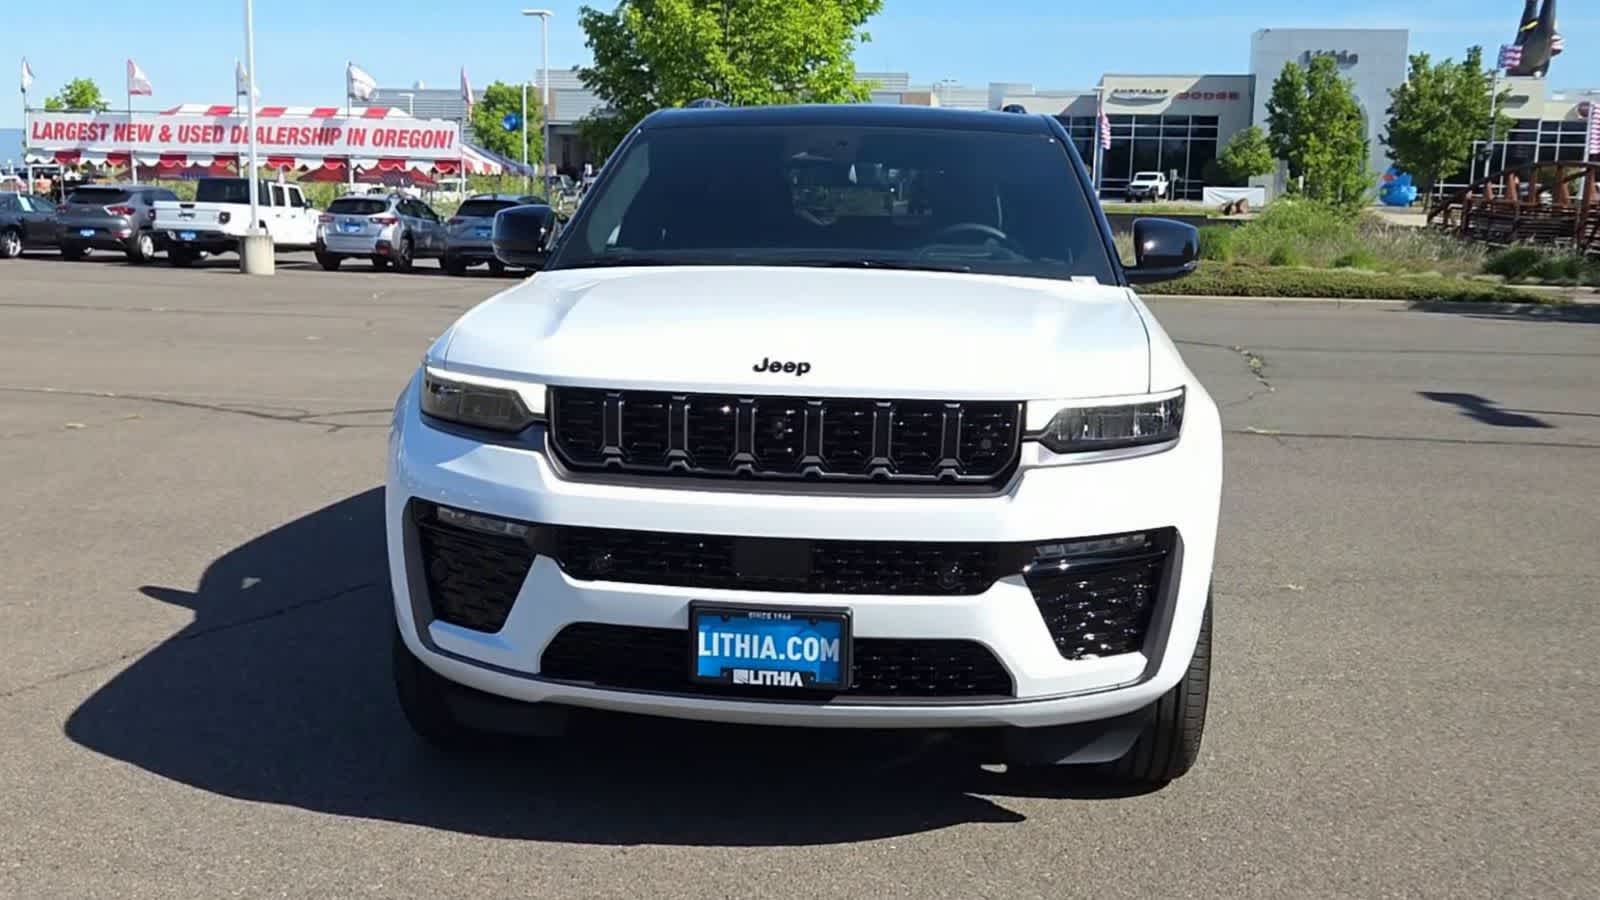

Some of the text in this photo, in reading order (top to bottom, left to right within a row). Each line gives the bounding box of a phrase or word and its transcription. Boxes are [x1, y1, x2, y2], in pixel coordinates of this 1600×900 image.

[32, 121, 109, 141] LARGEST
[113, 124, 155, 143] NEW
[158, 125, 172, 143] &
[178, 125, 224, 144] USED
[347, 128, 367, 146] IN
[372, 129, 455, 149] OREGON!
[752, 357, 811, 376] Jeep
[698, 631, 840, 662] LITHIA.COM
[749, 670, 804, 687] LITHIA
